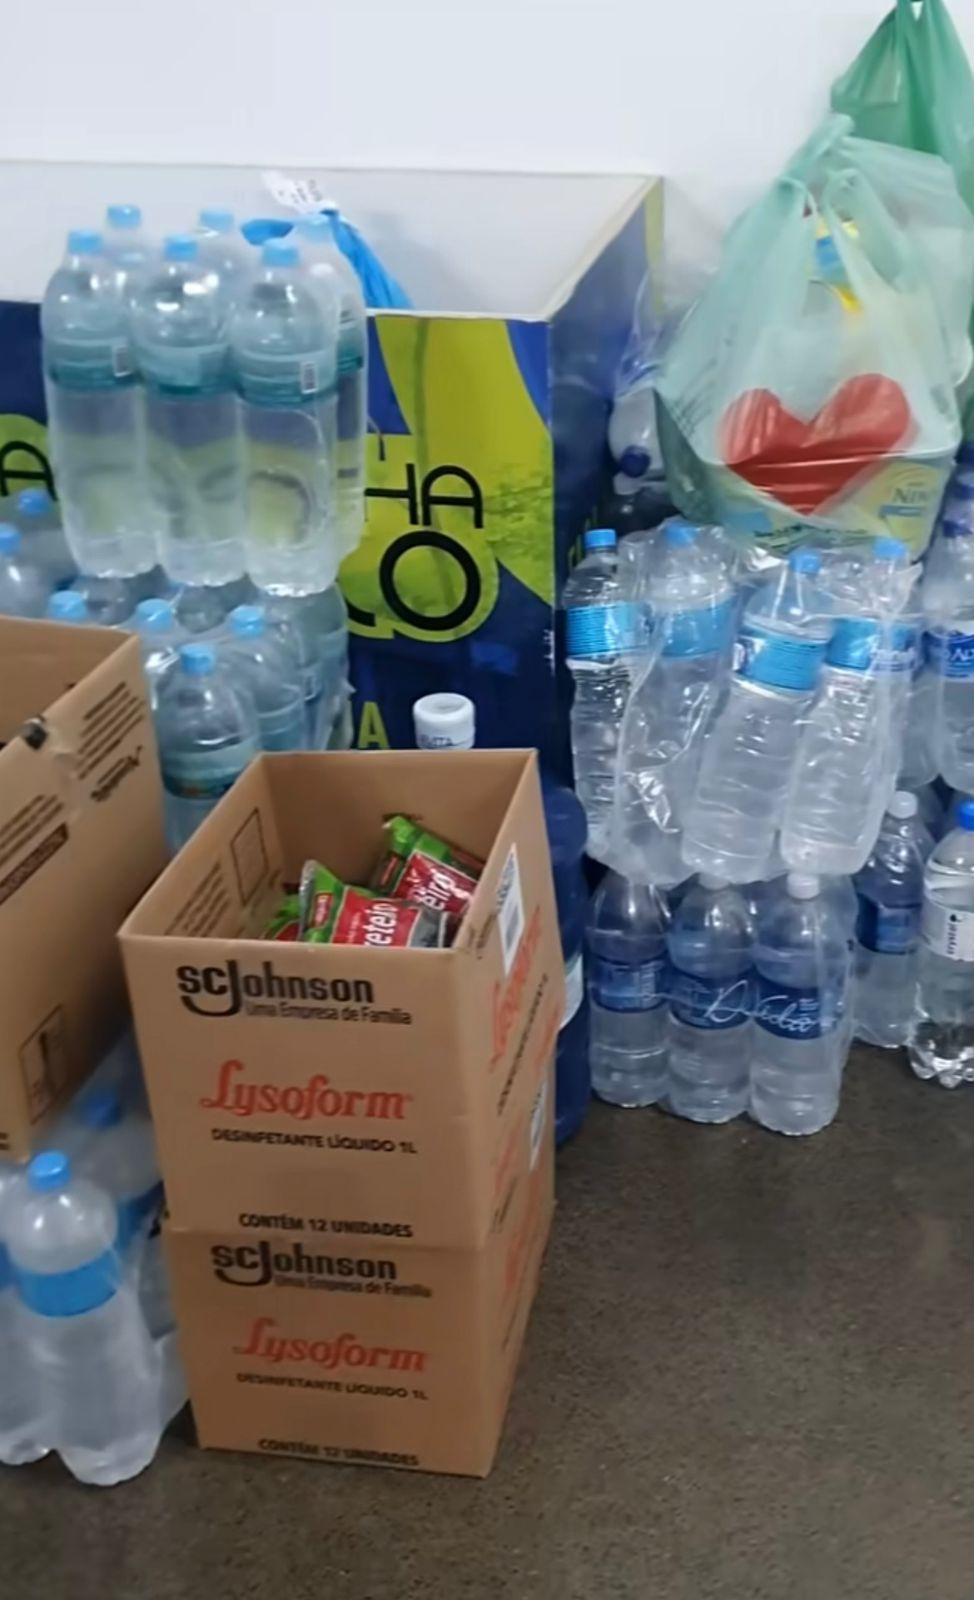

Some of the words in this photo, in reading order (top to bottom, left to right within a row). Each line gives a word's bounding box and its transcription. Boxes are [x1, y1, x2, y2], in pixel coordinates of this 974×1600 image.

[279, 1002, 339, 1020] Empresa
[342, 1006, 359, 1022] de
[200, 1059, 408, 1120] Lysoform
[211, 1128, 324, 1148] DESINFETANTE
[238, 1213, 304, 1230] CONTÉM
[308, 1218, 327, 1232] 12
[330, 1220, 413, 1238] UNIDADES
[365, 1281, 382, 1295] de
[233, 1317, 427, 1371] Lysoform
[236, 1373, 342, 1392] DESINFETANTE
